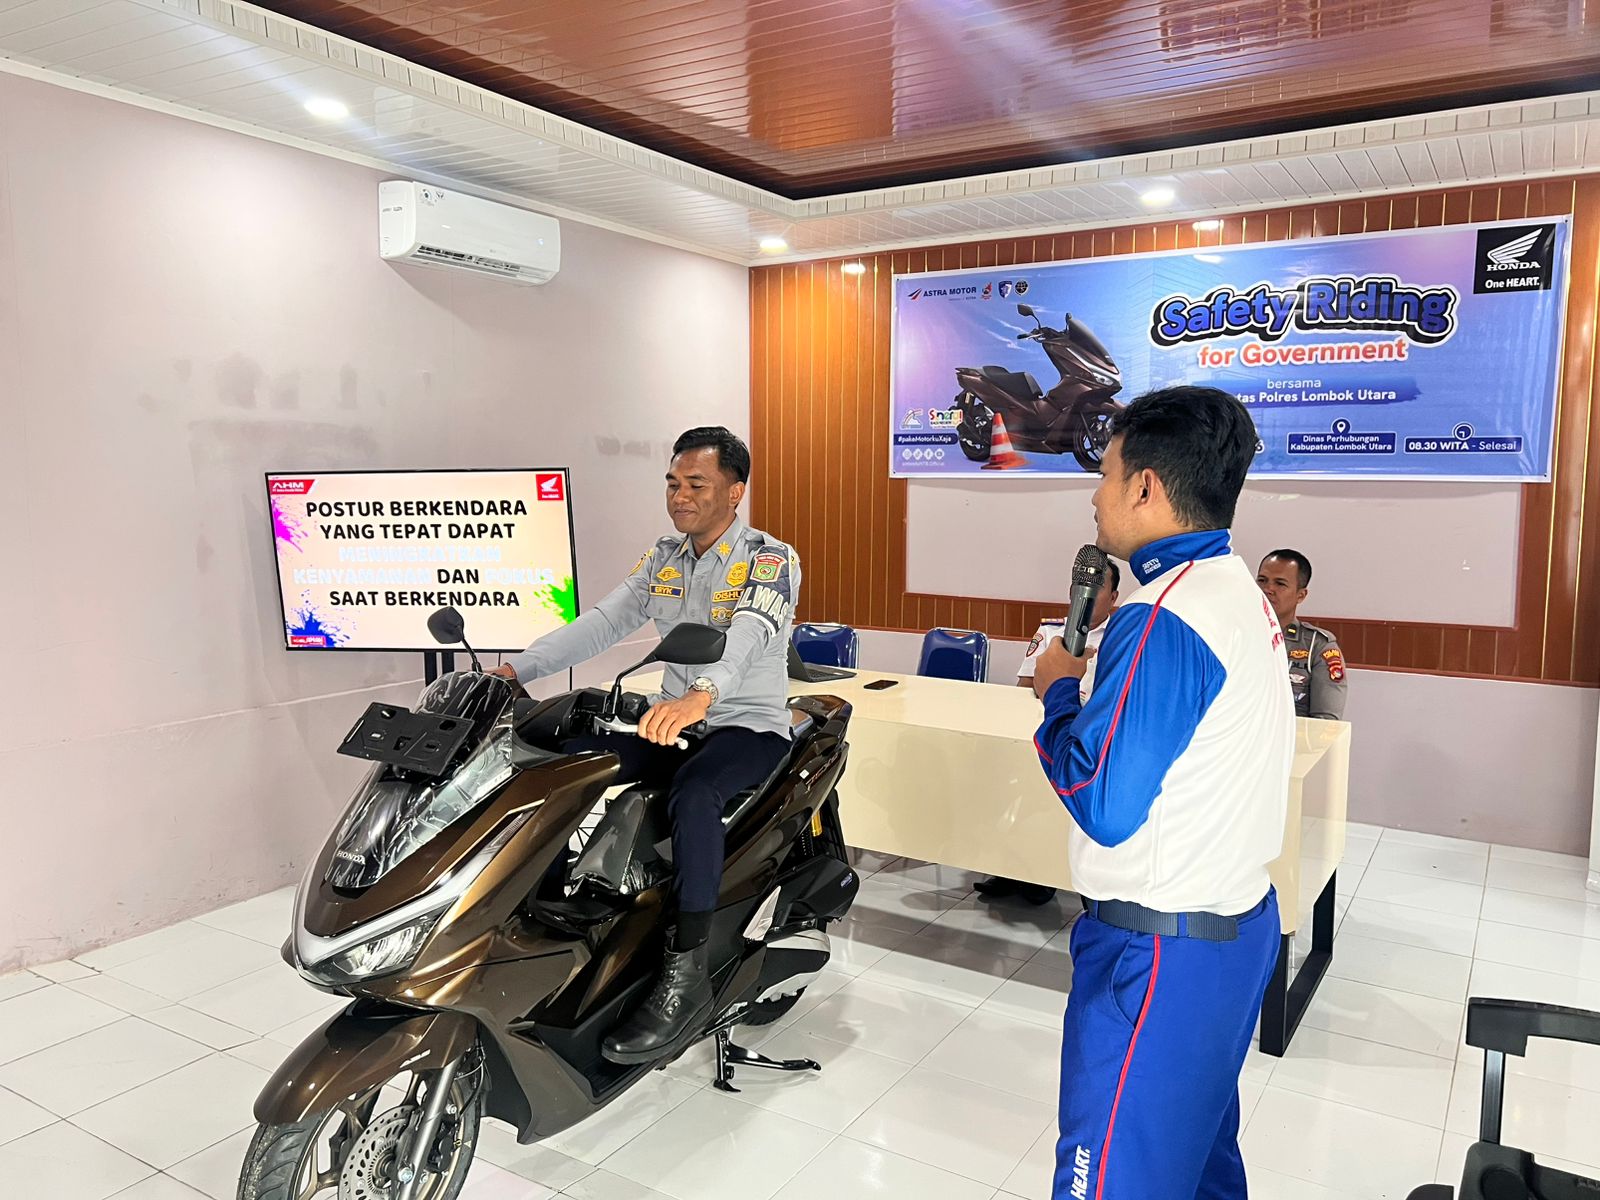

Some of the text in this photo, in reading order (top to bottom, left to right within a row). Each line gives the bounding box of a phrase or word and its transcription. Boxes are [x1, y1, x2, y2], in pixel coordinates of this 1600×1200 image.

[1486, 261, 1541, 272] HONDA
[1485, 276, 1540, 289] One HEART.
[923, 286, 977, 297] ASTRA MOTOR
[1159, 279, 1455, 338] Safety Riding
[1198, 339, 1407, 366] for Government
[1266, 378, 1322, 389] bersama
[1259, 391, 1298, 403] Polres
[1302, 390, 1354, 402] Lombok
[1357, 389, 1397, 401] Utara
[1302, 434, 1380, 444] Dinas Perhubungan
[1408, 441, 1438, 451] 08.30
[1440, 441, 1469, 450] WITA
[1478, 440, 1517, 450] Selesai
[1290, 443, 1392, 452] Kabupaten Lombok Utara
[272, 481, 305, 489] AHM
[306, 499, 528, 518] POSTUR BERKENDARA
[319, 522, 516, 540] YANG TEPAT DAPAT
[436, 568, 480, 585] DAN
[329, 590, 520, 607] SAAT BERKENDARA
[714, 590, 741, 600] DISHU
[336, 850, 366, 865] HONDA
